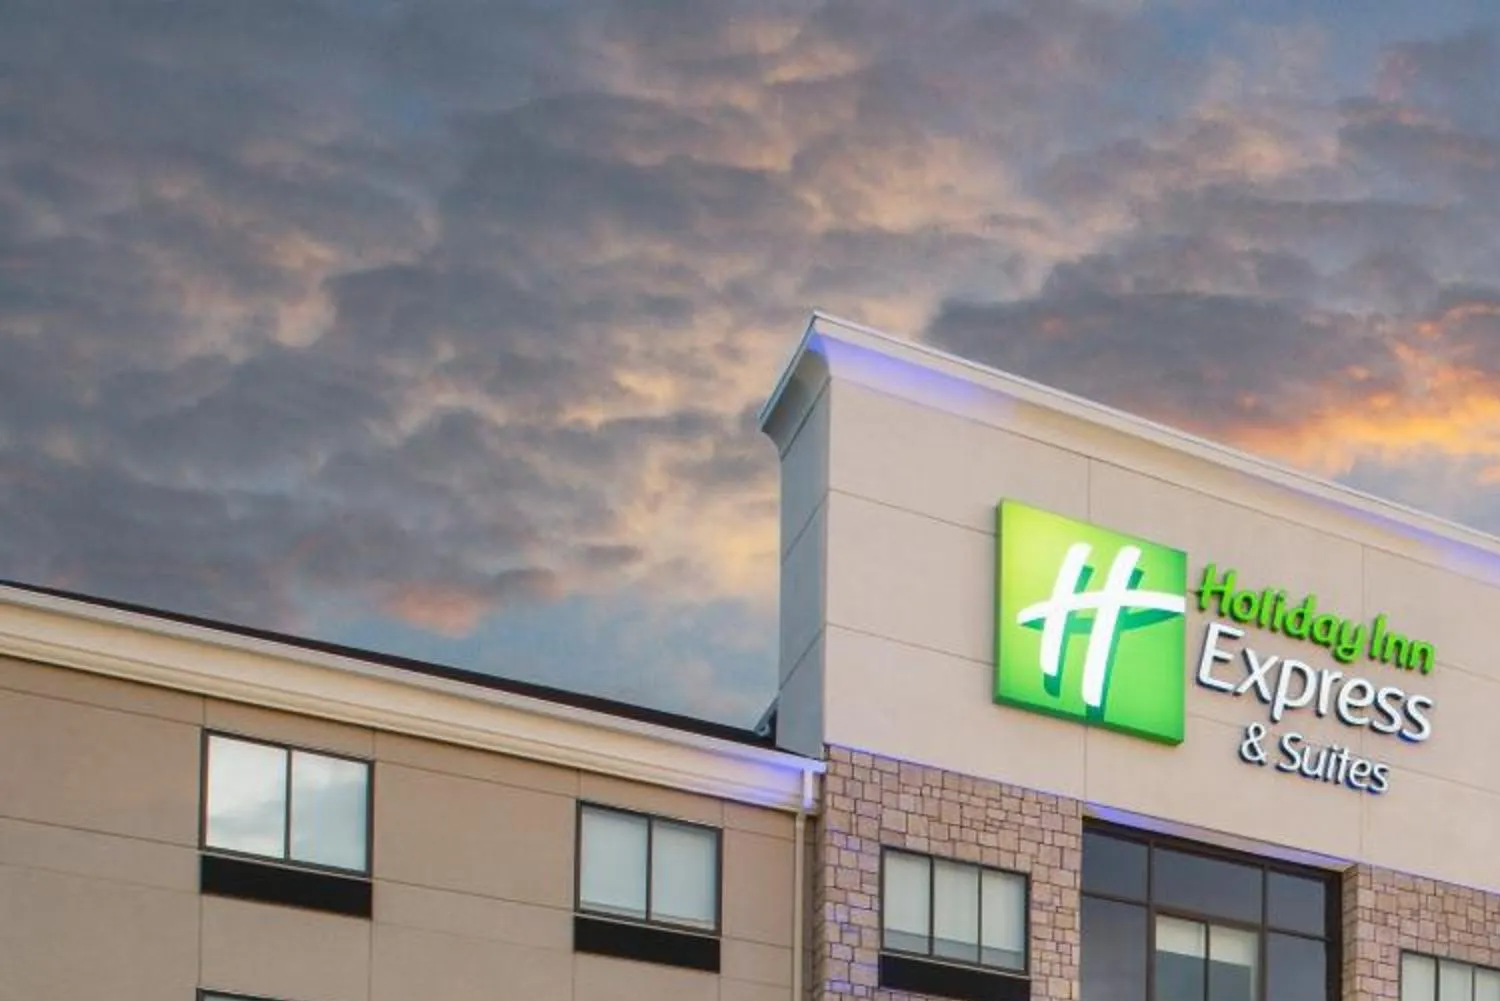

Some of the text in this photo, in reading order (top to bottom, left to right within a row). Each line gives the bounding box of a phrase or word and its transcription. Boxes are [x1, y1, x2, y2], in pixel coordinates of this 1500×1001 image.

[1198, 564, 1435, 673] Holiday Inn
[1197, 623, 1433, 743] Express
[1240, 722, 1389, 794] & Suites
